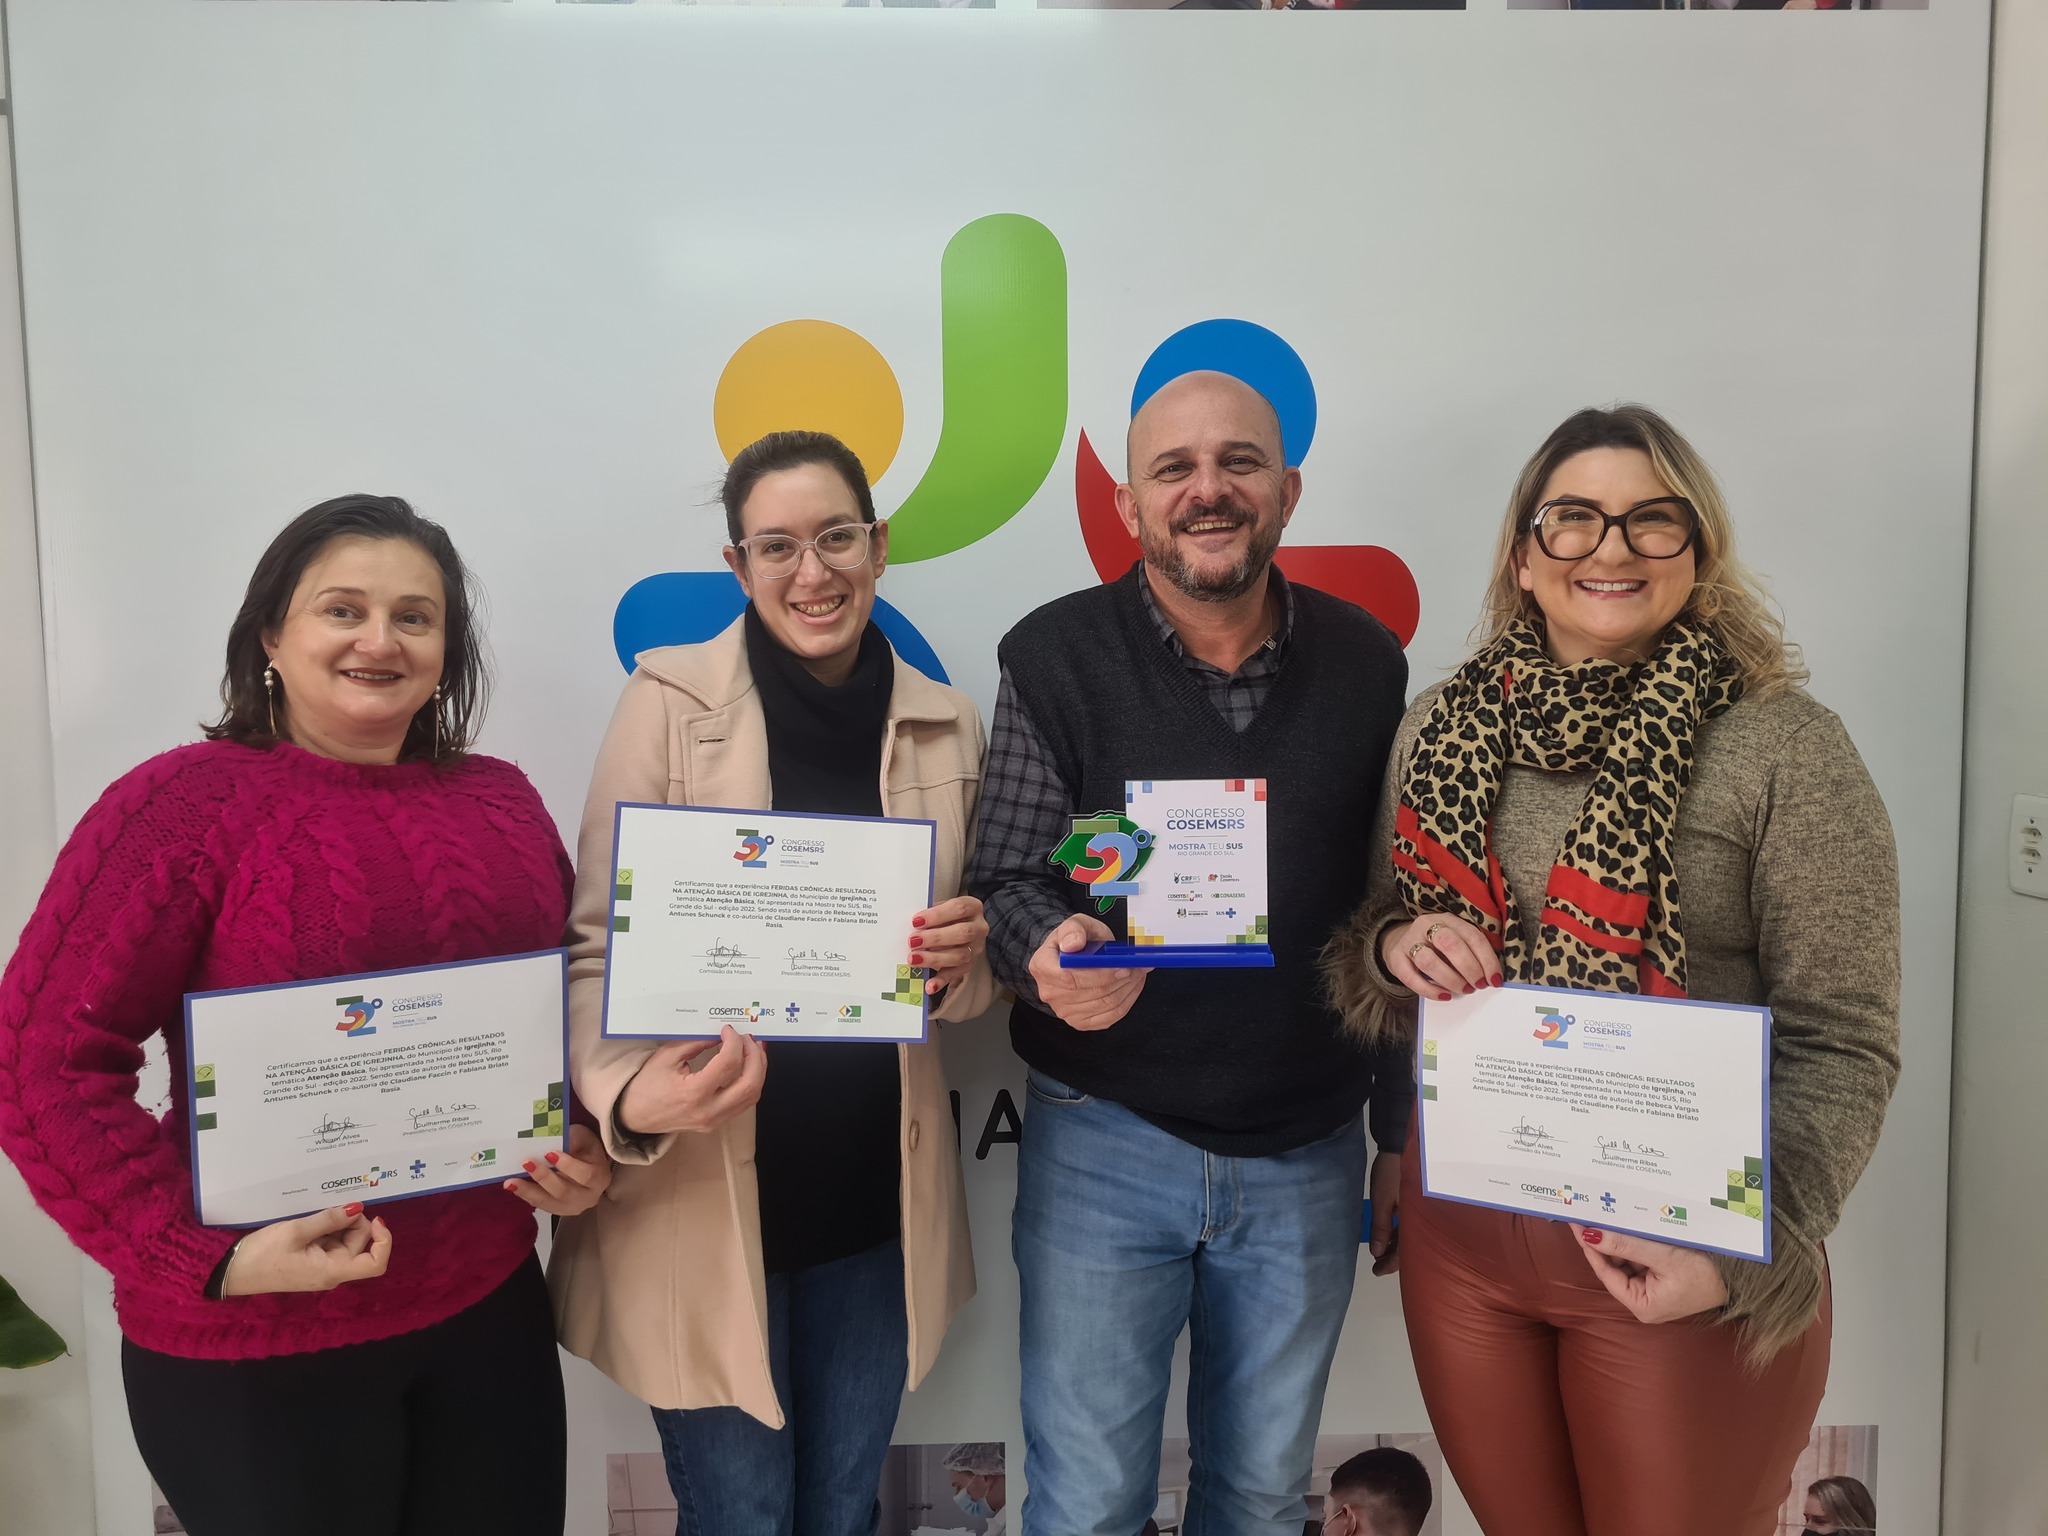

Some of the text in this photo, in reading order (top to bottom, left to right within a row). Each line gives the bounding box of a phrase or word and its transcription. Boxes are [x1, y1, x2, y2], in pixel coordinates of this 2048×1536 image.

[1166, 808, 1245, 819] CONGRESSO
[1167, 819, 1245, 830] COSEMSRS
[781, 838, 825, 846] CONGRESSO
[1226, 842, 1243, 850] SUS
[781, 844, 824, 853] COSEMSRS
[683, 887, 715, 896] ATENÇÃO
[705, 896, 732, 904] Atenção
[392, 992, 442, 1005] CONGRESSO
[392, 999, 442, 1012] COSEMSRS
[709, 1007, 743, 1015] cosems
[1583, 1019, 1631, 1030] CONGRESSO
[1583, 1025, 1631, 1037] COSEMSRS
[1476, 1054, 1515, 1065] Certificamos
[1535, 1062, 1572, 1073] experiência
[1574, 1067, 1604, 1077] FERIDAS
[1646, 1076, 1695, 1088] RESULTADOS
[1485, 1062, 1516, 1073] ATENÇÃO
[1518, 1066, 1543, 1076] BÁSICA
[1605, 1078, 1639, 1090] Município
[1479, 1070, 1506, 1079] temática
[1507, 1073, 1534, 1083] Atenção
[1570, 1082, 1611, 1094] apresentada
[1623, 1088, 1647, 1098] Mostra
[1679, 1096, 1691, 1104] Rio
[321, 1169, 397, 1189] cosems RS
[411, 1172, 424, 1180] SUS
[1521, 1182, 1556, 1196] cosems
[1579, 1193, 1589, 1202] RS
[1602, 1205, 1615, 1213] SUS
